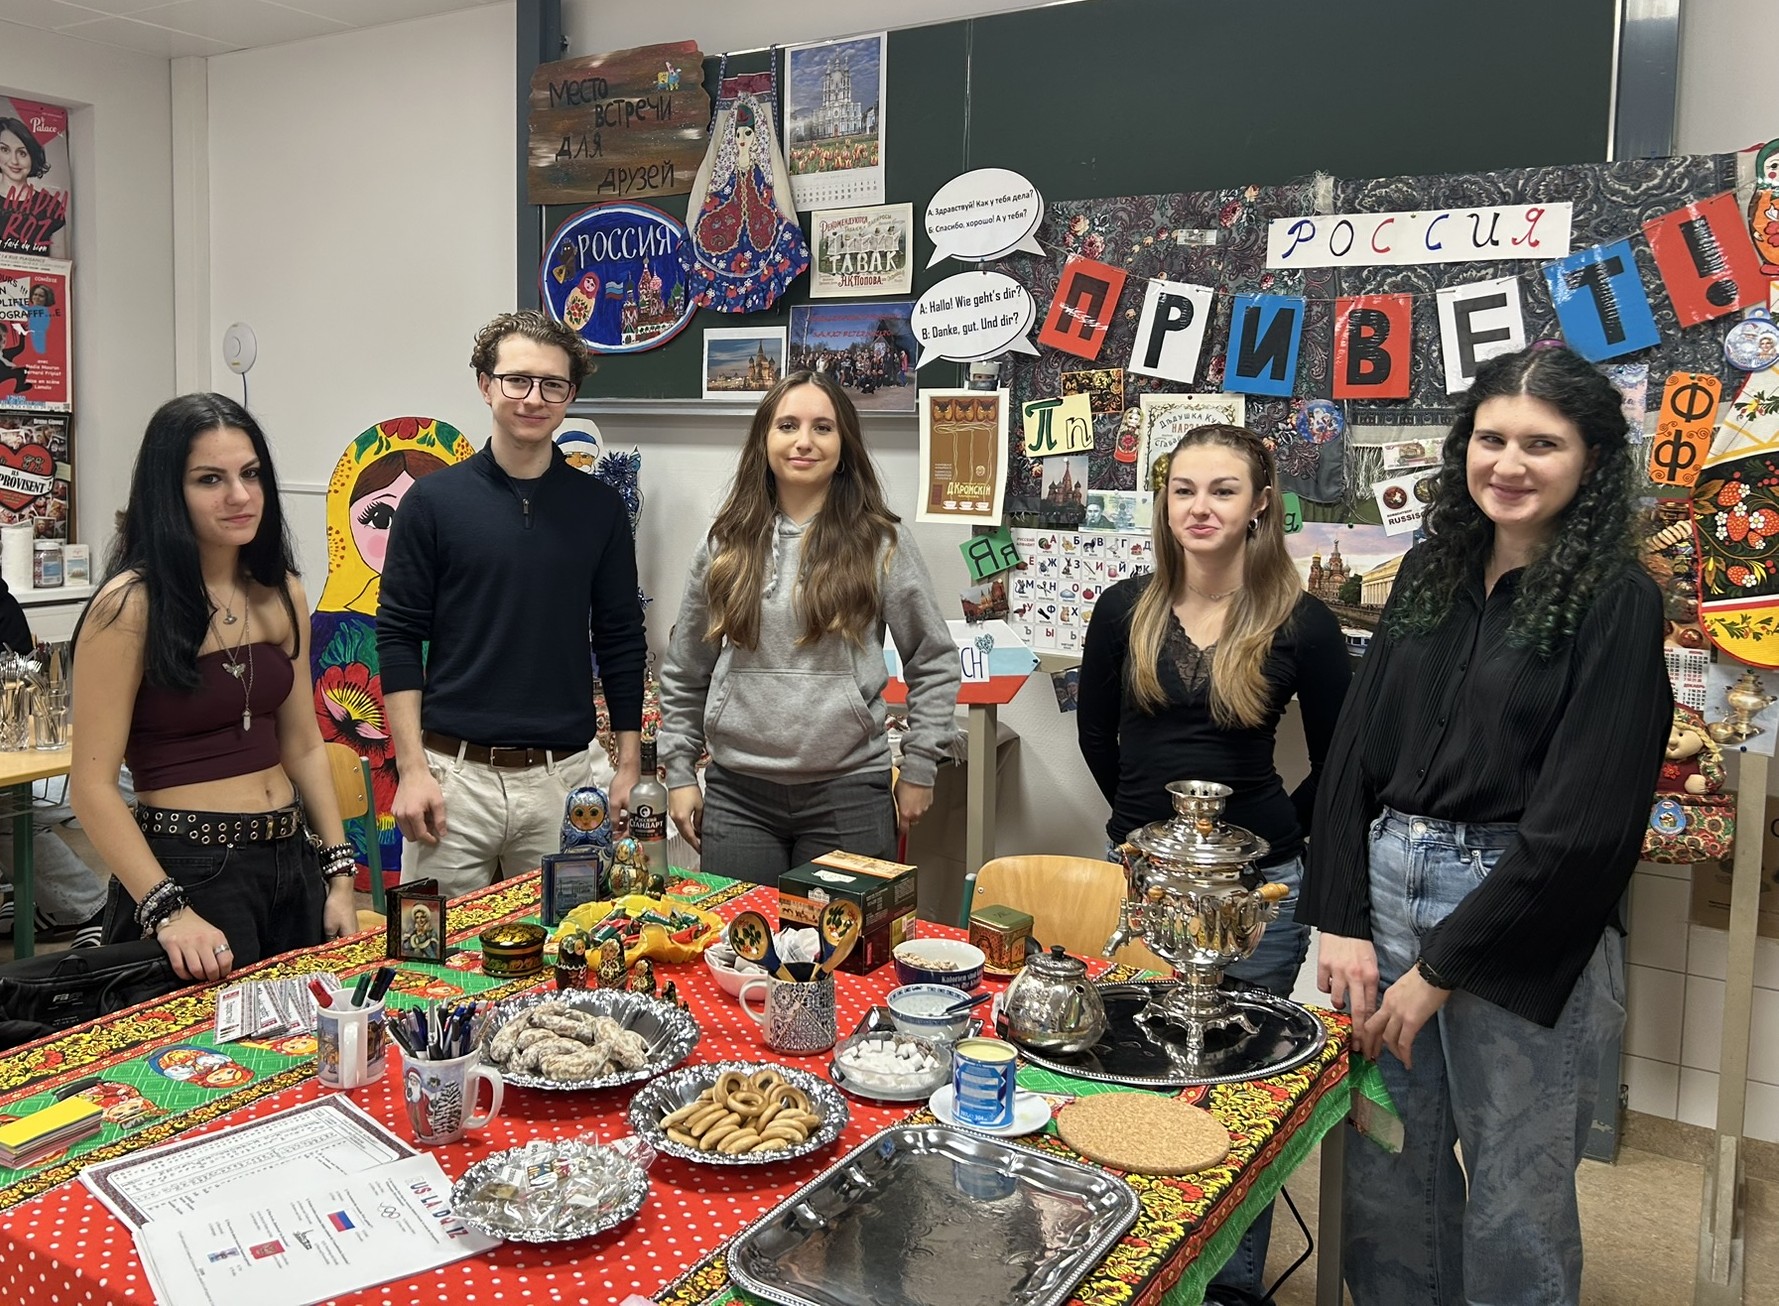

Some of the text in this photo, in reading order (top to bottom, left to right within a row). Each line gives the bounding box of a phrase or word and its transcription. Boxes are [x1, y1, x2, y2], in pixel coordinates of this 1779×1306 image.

[30, 117, 57, 133] Palace
[4, 183, 69, 221] NADIA
[935, 200, 975, 216] Здравствуй!
[976, 200, 989, 208] Как
[995, 195, 1011, 204] тебя
[1012, 189, 1034, 202] дела?
[935, 222, 965, 233] Спасибо,
[966, 216, 994, 228] хорошо!
[1008, 208, 1028, 220] тебя?
[2, 213, 53, 246] ROZ
[1282, 207, 1545, 259] РОССИЯ
[21, 240, 30, 251] du
[578, 225, 671, 269] РОССИЯ
[920, 303, 928, 315] A:
[929, 298, 954, 313] Hallo!
[955, 295, 971, 308] Wie
[1003, 284, 1022, 300] dir?
[922, 312, 1019, 340] B: Danke, gut. Und dir?
[1050, 535, 1057, 544] А
[1073, 536, 1080, 545] Б
[1097, 538, 1104, 546] В
[1121, 539, 1127, 548] Г
[1143, 541, 1152, 551] Д
[1048, 558, 1057, 567] Ж
[1074, 560, 1080, 569] З
[1096, 562, 1103, 571] И
[1119, 561, 1126, 572] Й
[1143, 565, 1150, 574] К
[1026, 580, 1034, 589] М
[1049, 582, 1056, 591] Н
[1072, 583, 1080, 592] О
[1095, 586, 1102, 594] П
[1027, 603, 1034, 612] У
[1046, 604, 1056, 614] Ф
[1071, 607, 1078, 616] Х
[1024, 626, 1032, 635] Ъ
[1046, 628, 1054, 638] Ы
[1070, 631, 1077, 640] Ь
